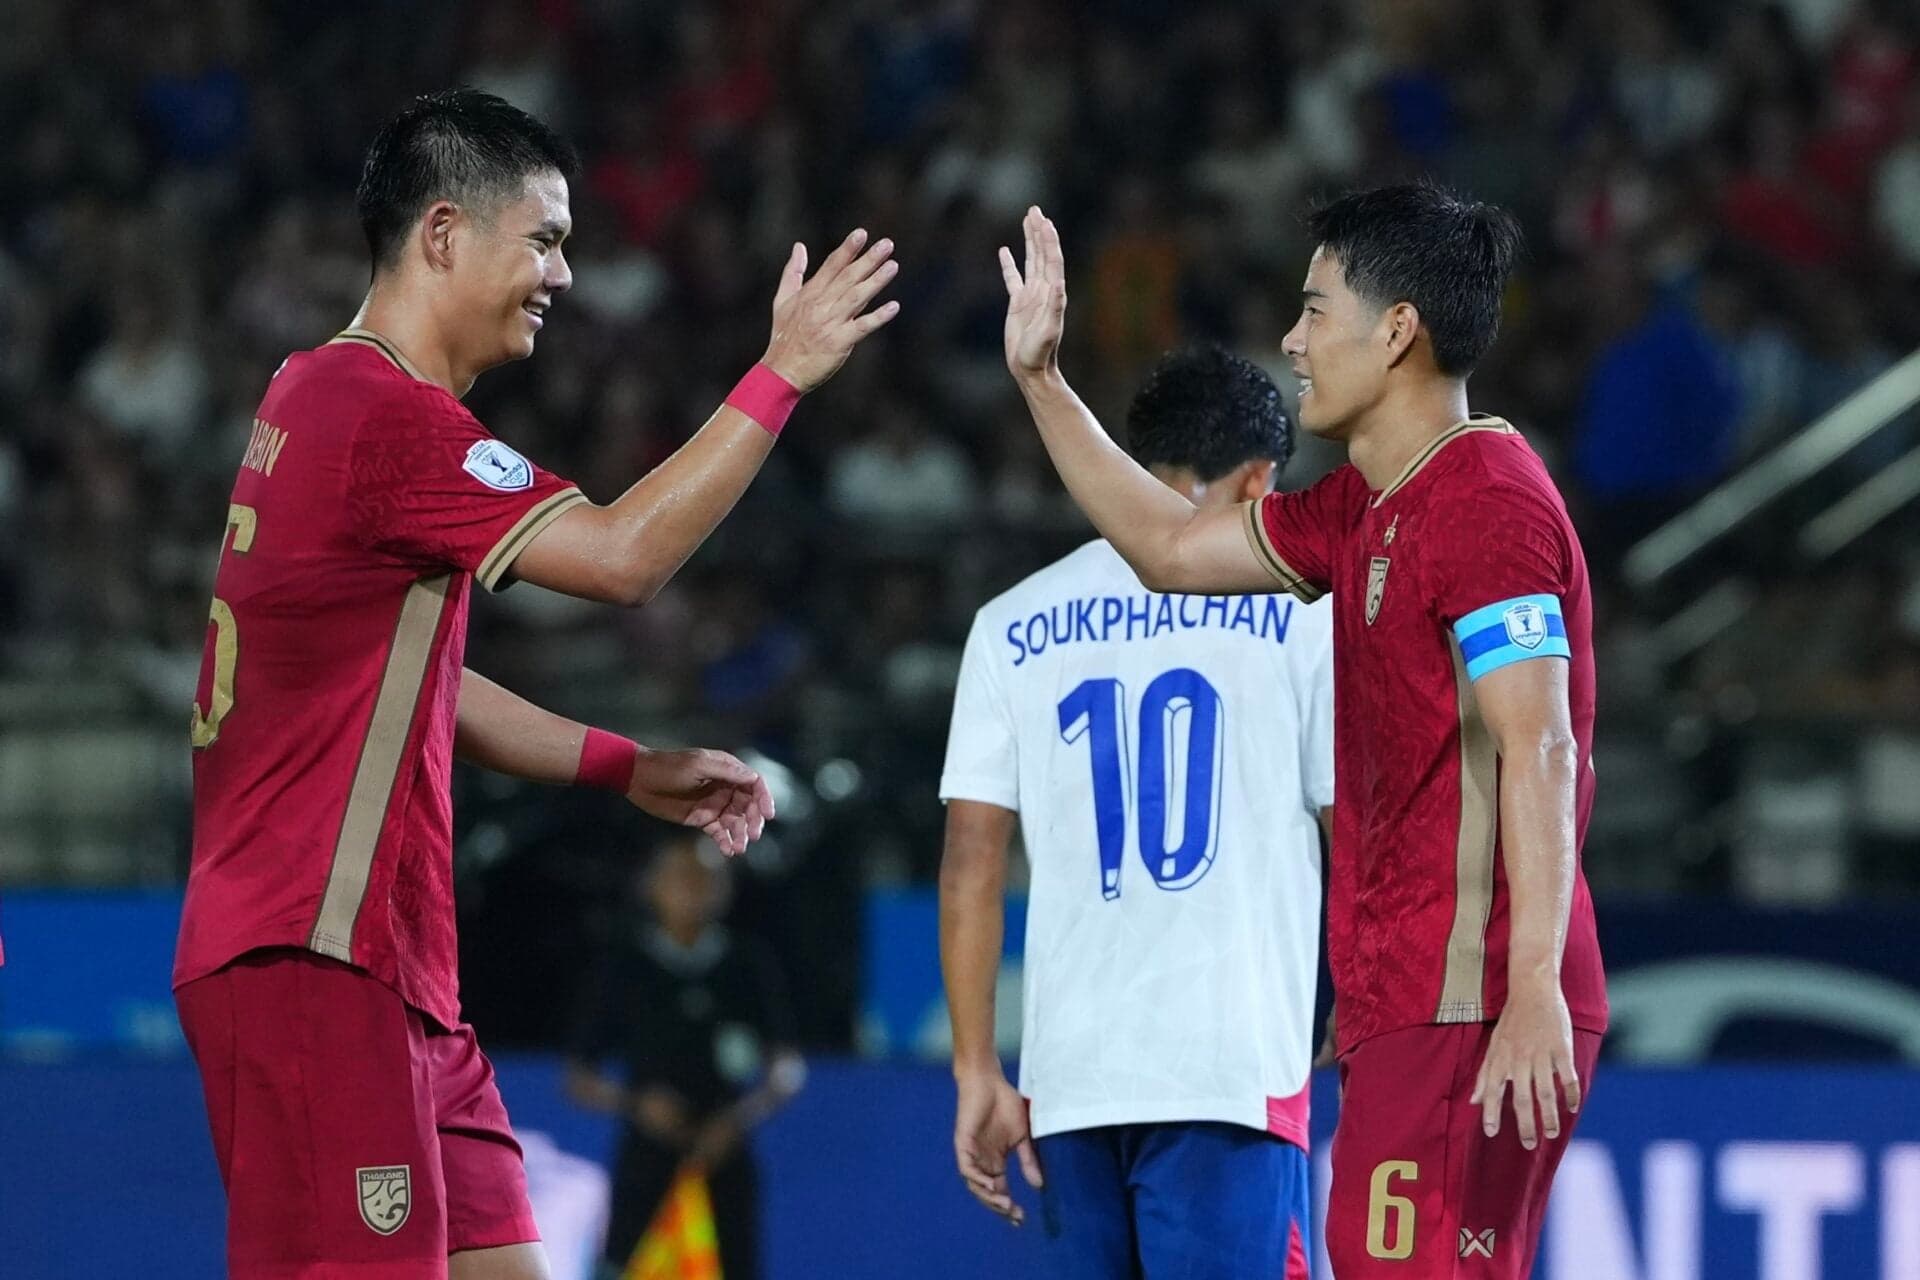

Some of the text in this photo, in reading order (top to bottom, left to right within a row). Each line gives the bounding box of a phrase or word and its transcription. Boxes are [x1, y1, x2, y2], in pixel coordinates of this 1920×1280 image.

[1007, 593, 1293, 667] SOUKPHACHAN
[1057, 667, 1225, 902] 10
[1366, 1159, 1419, 1260] 6
